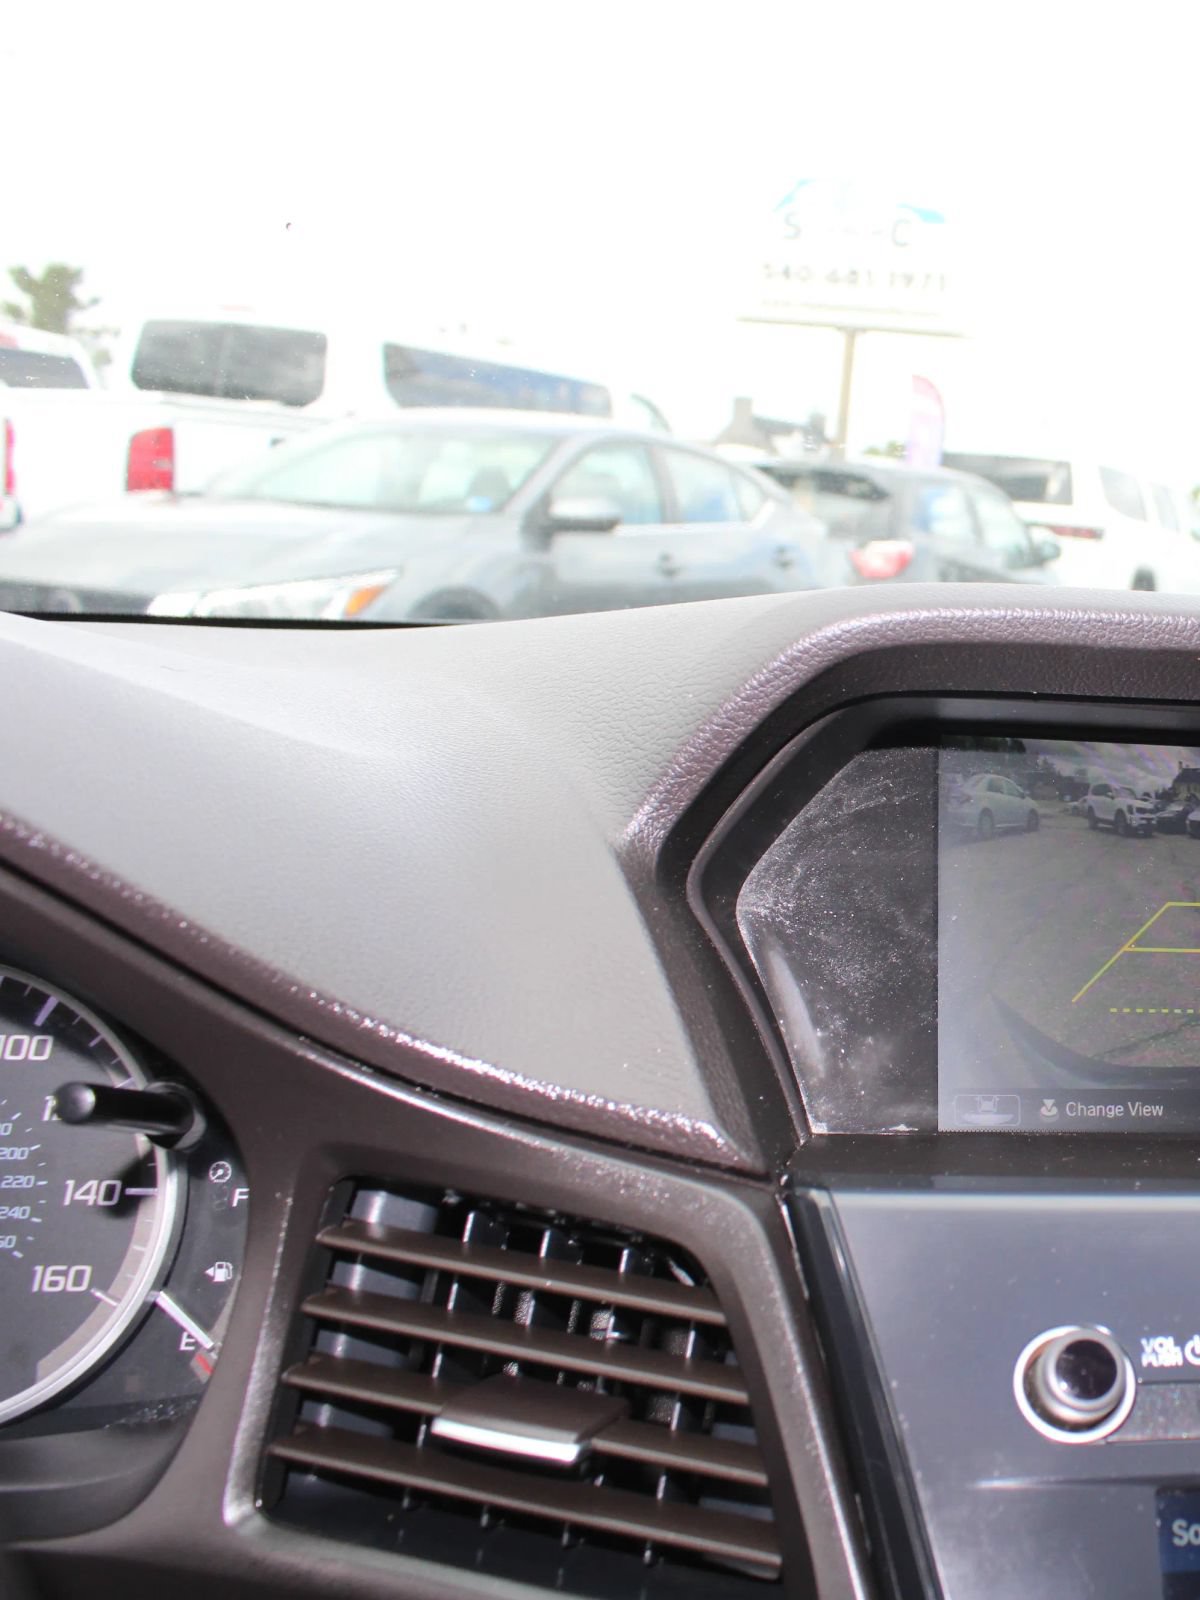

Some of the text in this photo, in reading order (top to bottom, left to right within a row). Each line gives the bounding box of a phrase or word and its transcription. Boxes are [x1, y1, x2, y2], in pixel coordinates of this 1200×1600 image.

[1066, 1101, 1164, 1119] Change View
[1, 1175, 35, 1188] 220
[63, 1179, 122, 1206] 140
[232, 1188, 250, 1207] F
[32, 1265, 92, 1293] 160
[179, 1332, 197, 1351] E
